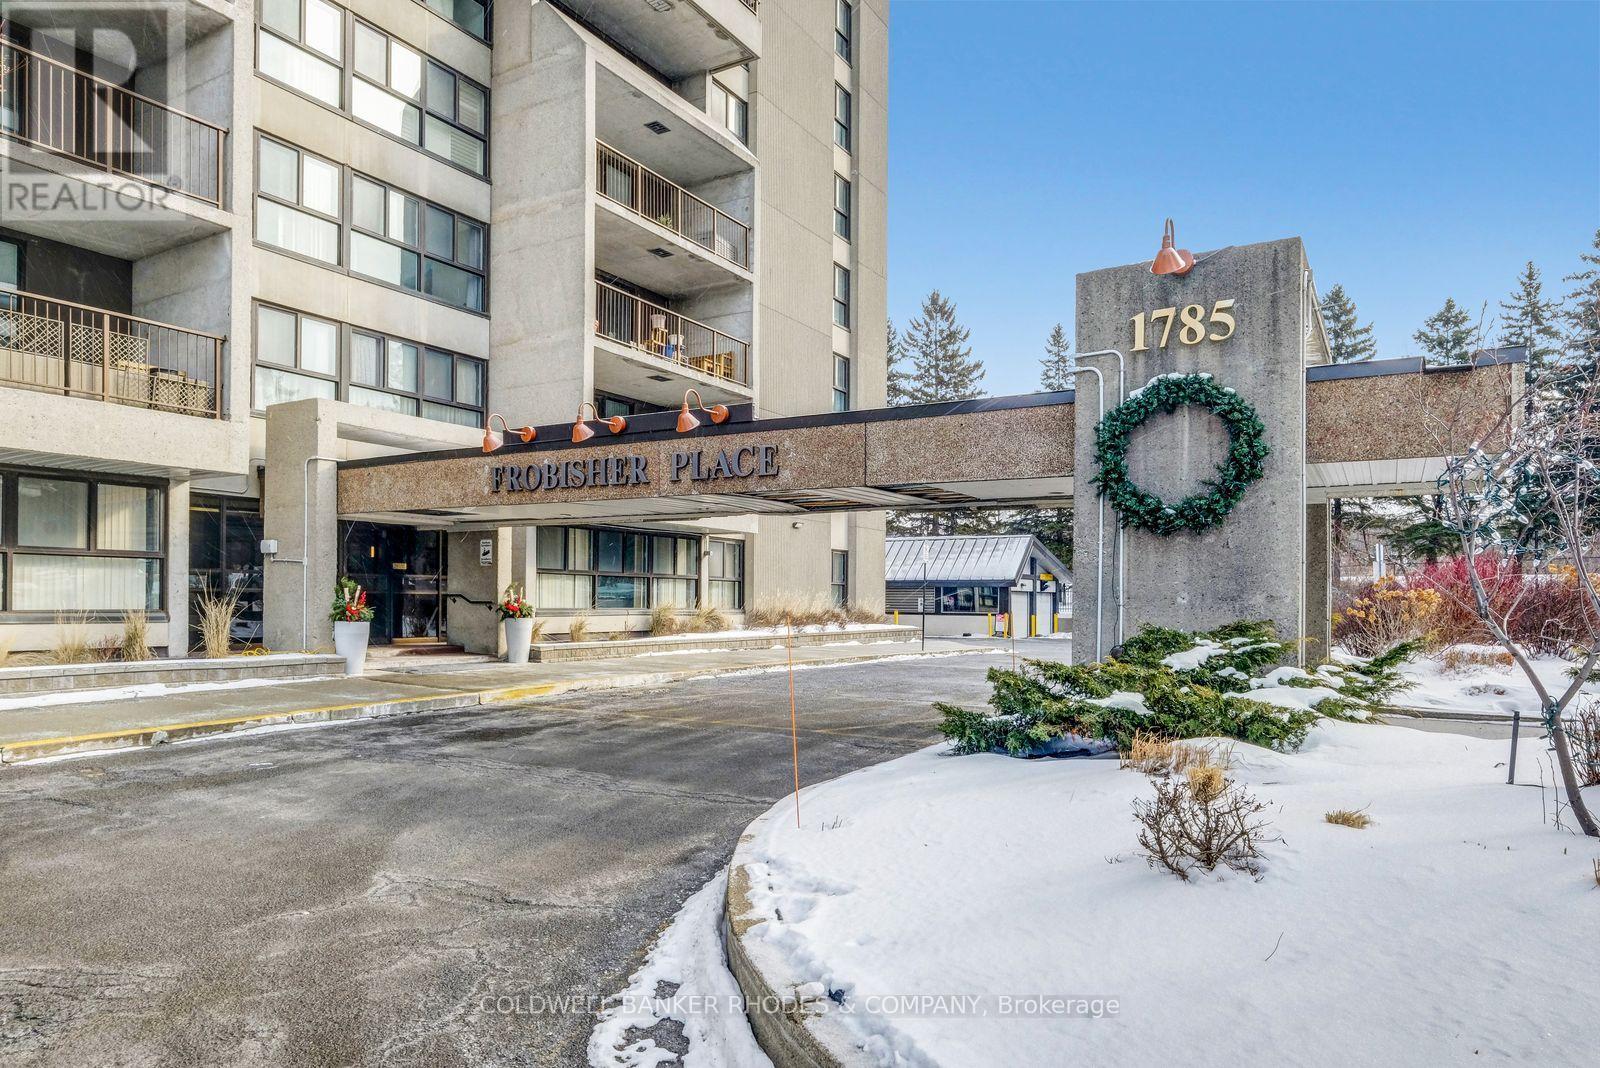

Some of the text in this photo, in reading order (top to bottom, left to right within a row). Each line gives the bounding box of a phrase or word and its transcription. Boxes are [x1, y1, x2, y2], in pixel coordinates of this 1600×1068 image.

[1129, 299, 1236, 352] 1785
[491, 444, 780, 493] FROBISHER PLACE
